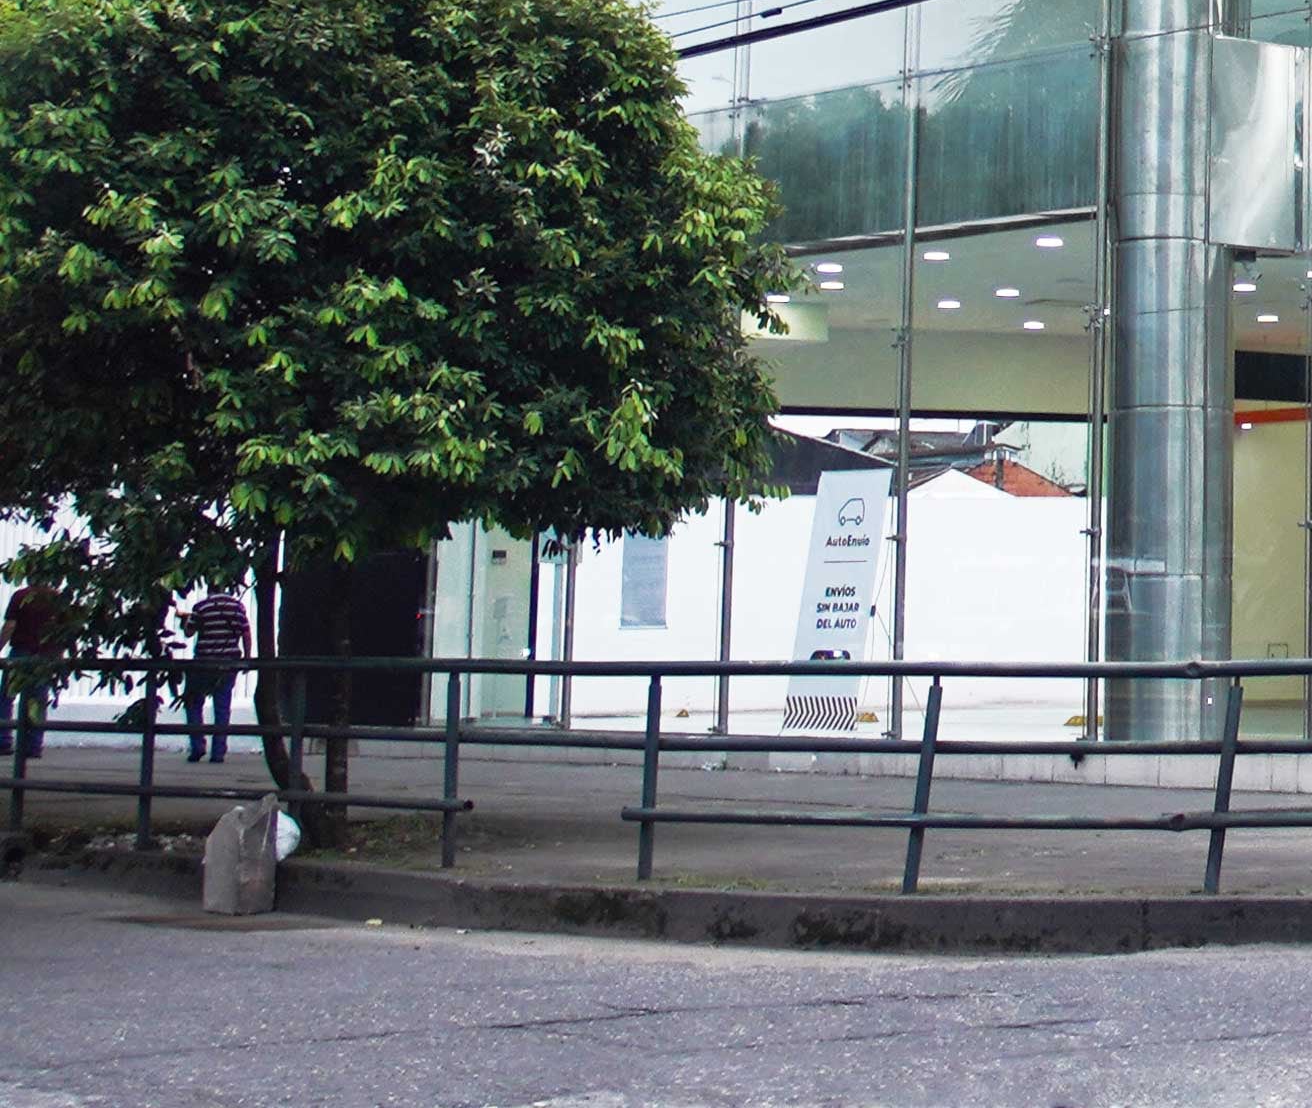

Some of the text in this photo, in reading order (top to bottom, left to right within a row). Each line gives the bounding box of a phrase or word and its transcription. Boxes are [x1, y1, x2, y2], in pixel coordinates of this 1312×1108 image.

[816, 602, 860, 613] SIN BAJAR
[816, 618, 857, 629] DEL AUTO
